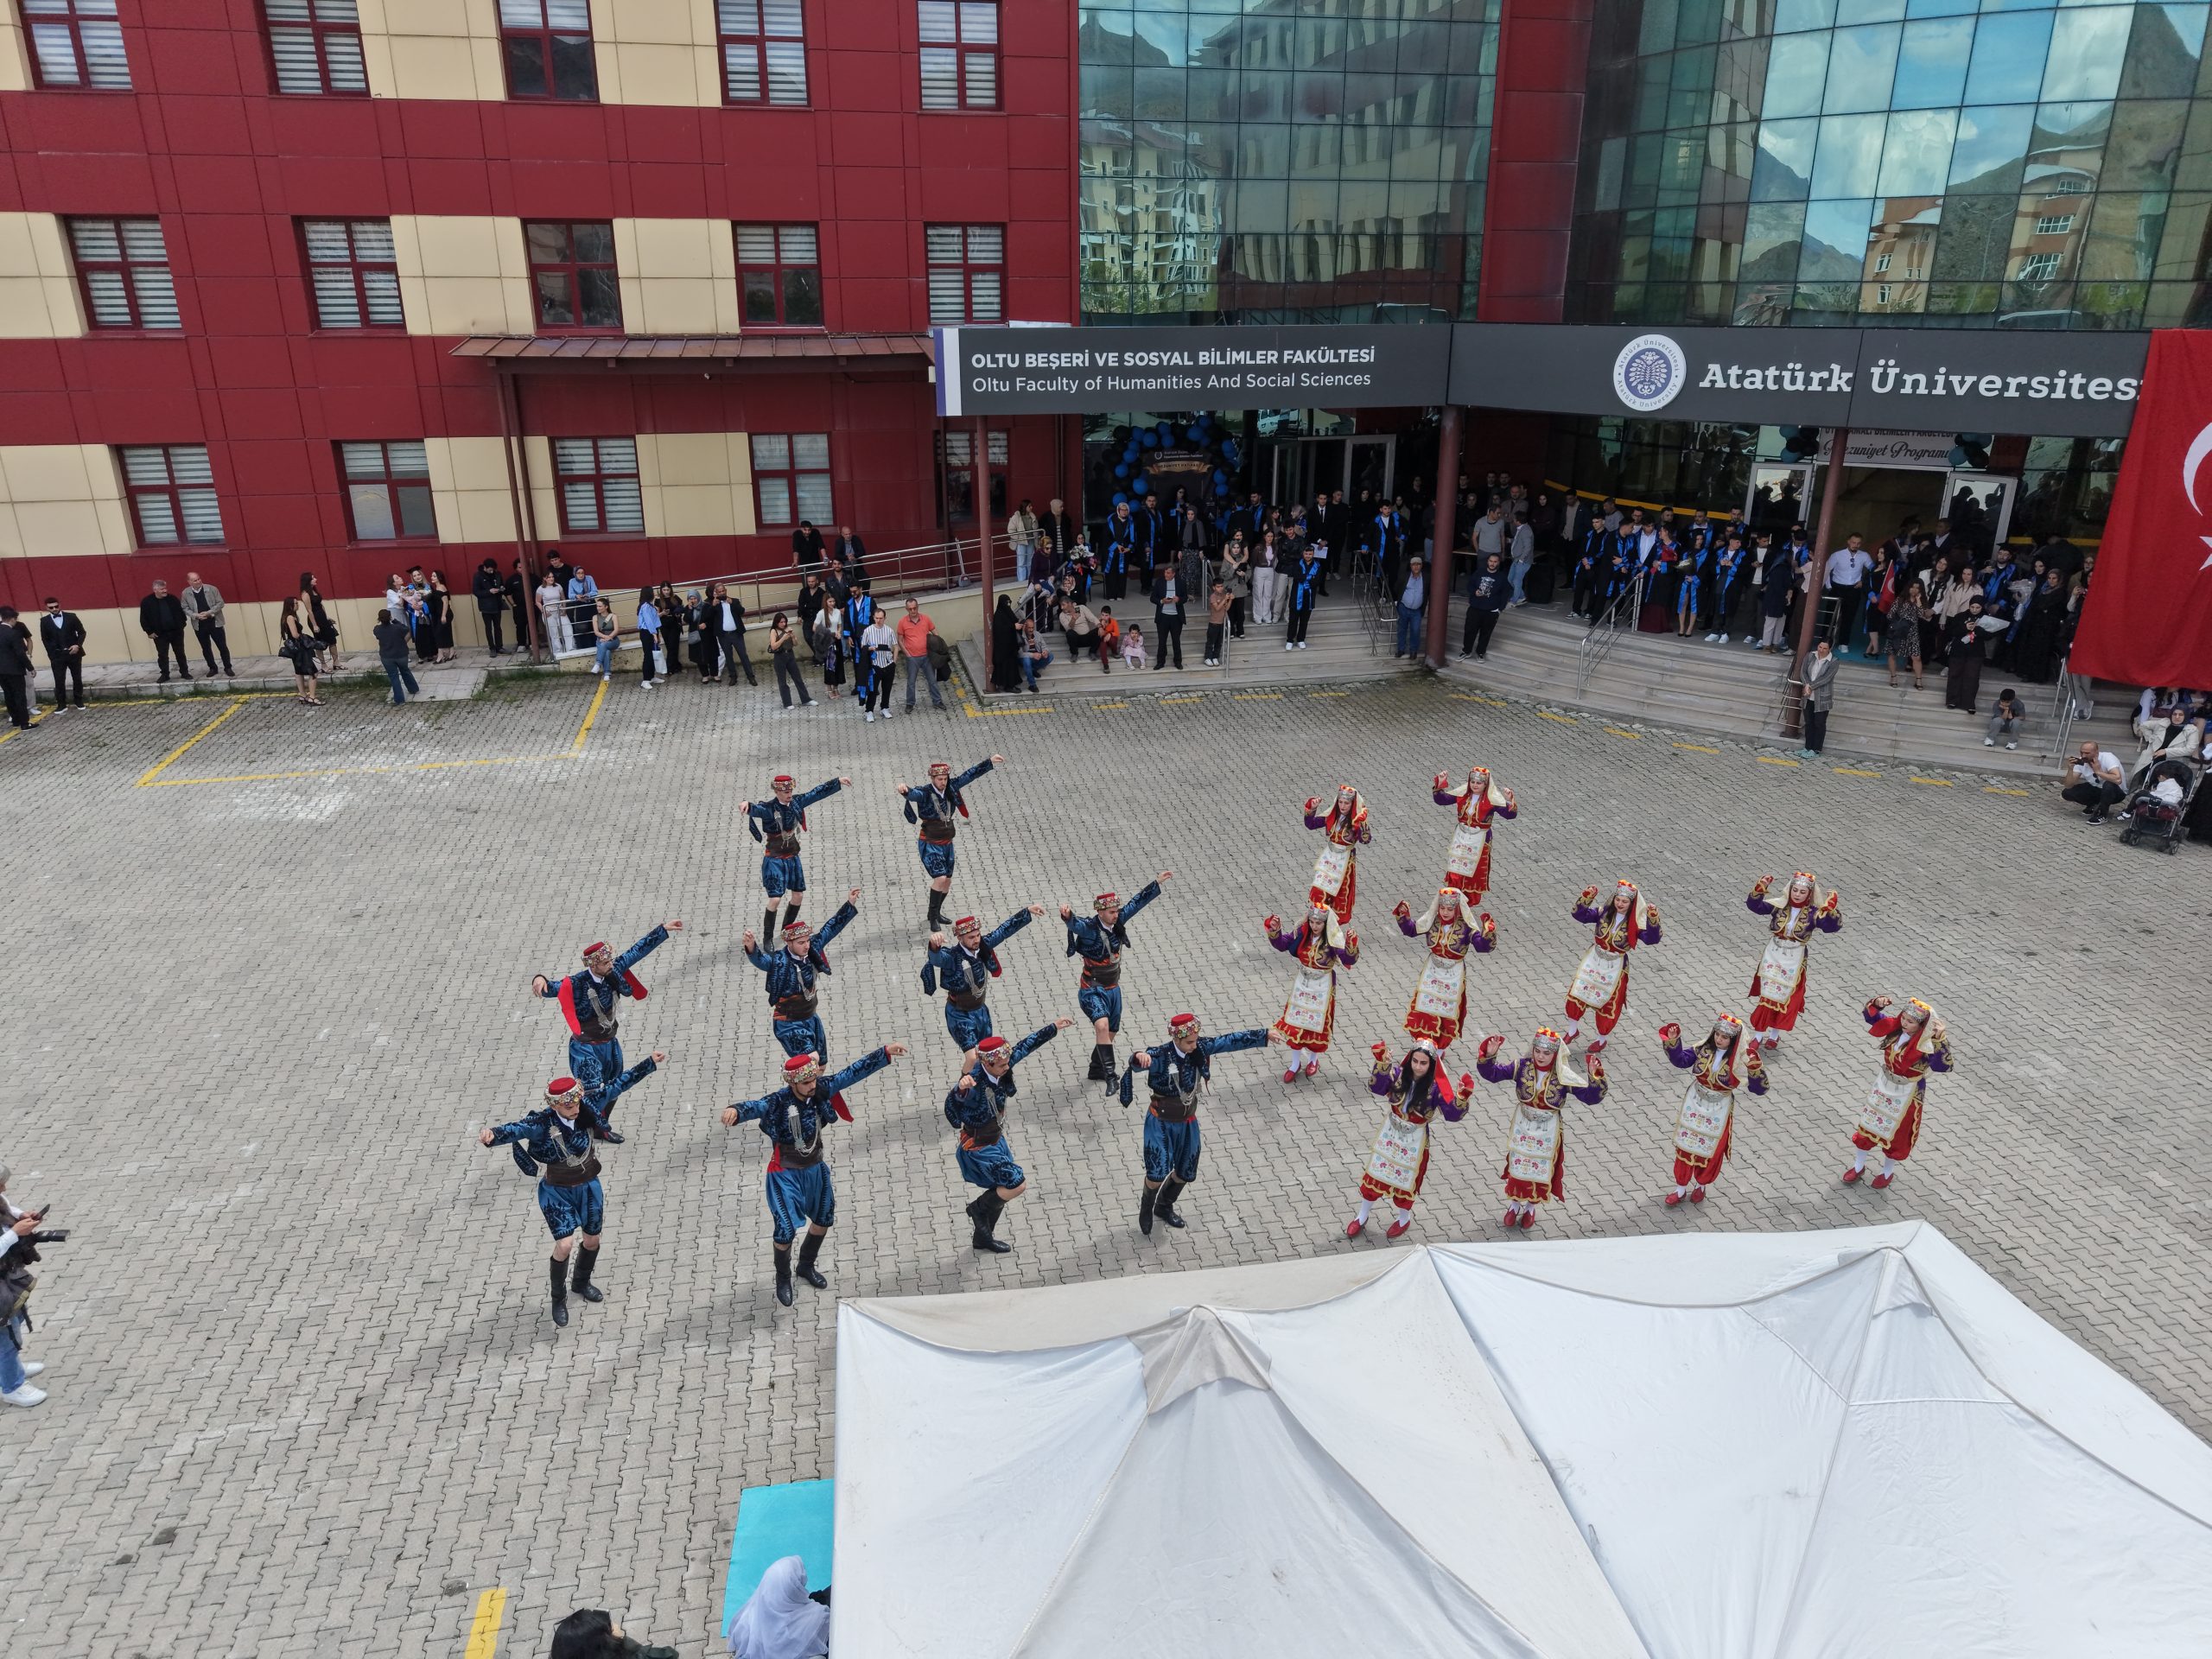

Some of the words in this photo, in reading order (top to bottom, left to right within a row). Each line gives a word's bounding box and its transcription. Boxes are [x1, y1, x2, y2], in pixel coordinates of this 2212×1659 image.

[971, 353, 1020, 369] OLTU
[1025, 349, 1090, 370] BEŞERİ
[1095, 352, 1119, 367] VE
[1123, 351, 1194, 366] SOSYAL
[1198, 347, 1279, 365] BİLİMLER
[1283, 346, 1375, 365] FAKÜLTESİ
[1618, 342, 1641, 369] Atatürk
[1643, 339, 1681, 372] Üniversitesi
[972, 377, 1010, 392] Oltu
[1016, 376, 1079, 394] Faculty
[1084, 375, 1103, 391] of
[1108, 374, 1202, 391] Humanities
[1207, 373, 1241, 389] And
[1246, 372, 1295, 388] Social
[1300, 372, 1371, 387] Sciences
[1618, 379, 1637, 406] Atatürk
[1699, 362, 1853, 392] Atatürk
[1870, 359, 2144, 401] Üniversites
